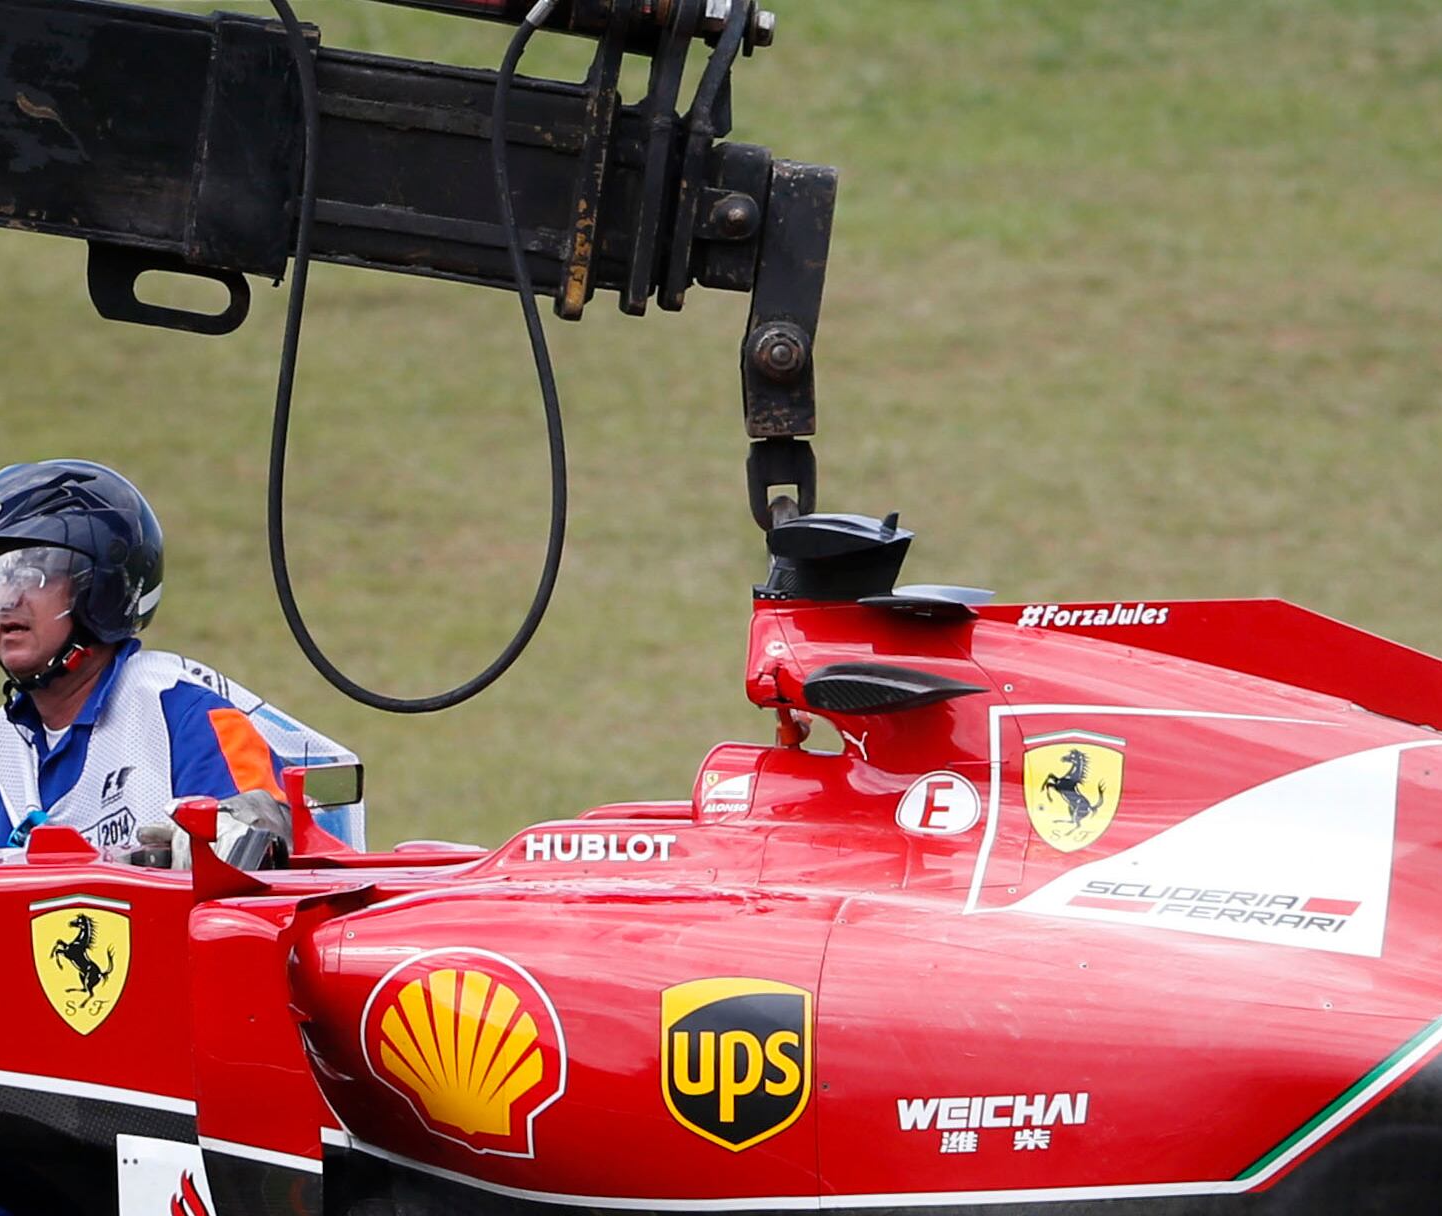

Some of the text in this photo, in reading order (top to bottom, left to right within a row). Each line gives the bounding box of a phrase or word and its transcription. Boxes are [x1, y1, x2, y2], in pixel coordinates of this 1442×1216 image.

[1017, 603, 1169, 629] #ForzaJules
[702, 803, 750, 814] ALONSO
[924, 780, 954, 826] E
[101, 813, 130, 847] 2014
[524, 833, 677, 863] HUBLOT
[1081, 880, 1299, 910] SCUDERIA
[1157, 903, 1347, 934] FERRARI
[673, 1030, 801, 1123] ups
[896, 1092, 1089, 1131] WEICHAI
[939, 1128, 1052, 1154] 潍柴
